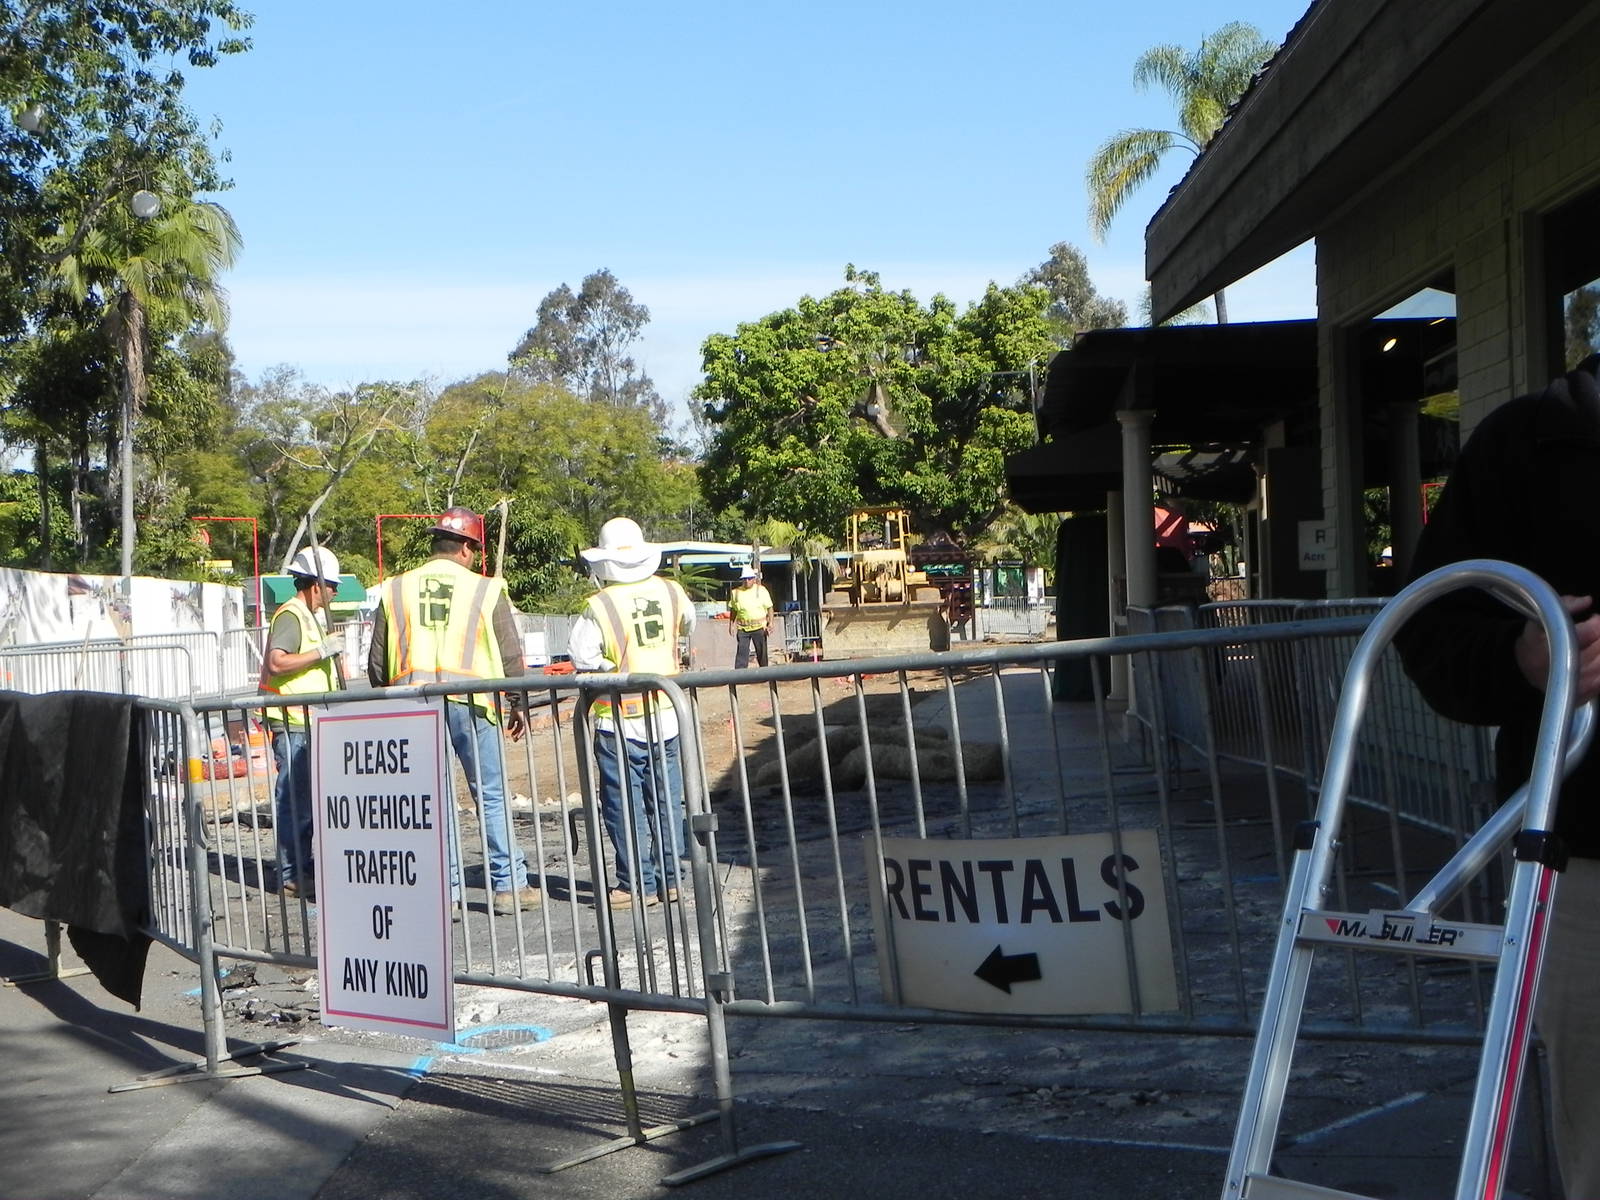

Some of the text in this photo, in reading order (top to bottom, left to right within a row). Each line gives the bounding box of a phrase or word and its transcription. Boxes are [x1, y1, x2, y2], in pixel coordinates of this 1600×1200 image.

[344, 738, 410, 775] PLEASE
[326, 794, 433, 830] NO VEHICLE
[344, 849, 417, 887] TRAFFIC
[883, 854, 1146, 924] RENTALS
[372, 904, 394, 940] OF
[342, 957, 429, 1000] ANY KIND
